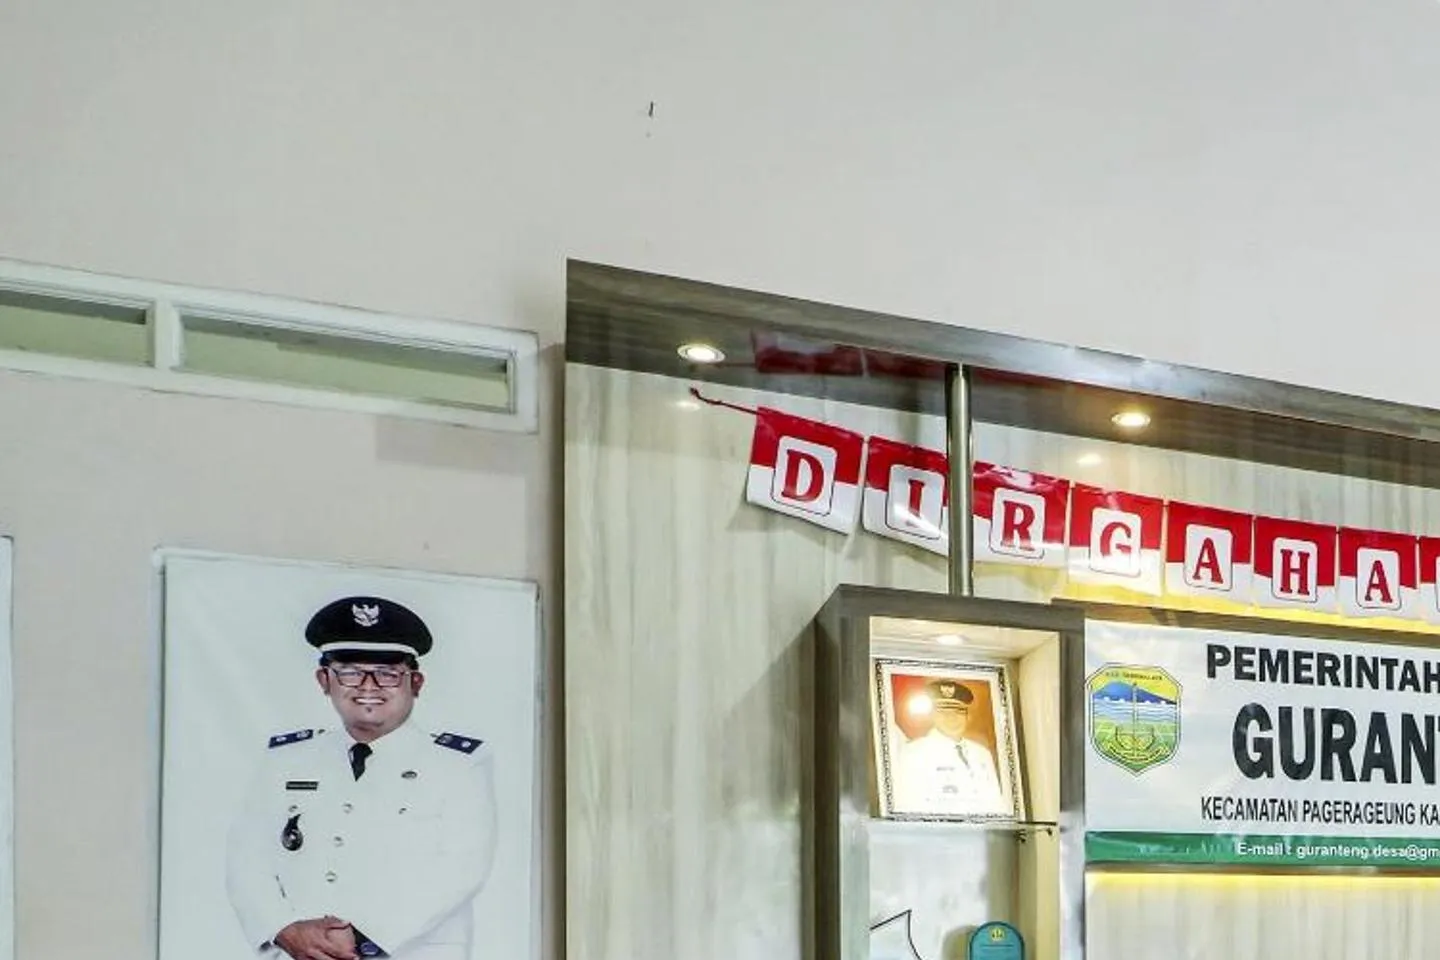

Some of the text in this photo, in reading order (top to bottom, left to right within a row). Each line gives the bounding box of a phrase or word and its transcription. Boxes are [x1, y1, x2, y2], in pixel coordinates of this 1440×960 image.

[1201, 796, 1298, 822] KECAMATAN
[1302, 800, 1416, 825] PAGERAGEUNG
[1236, 842, 1283, 856] E-mail
